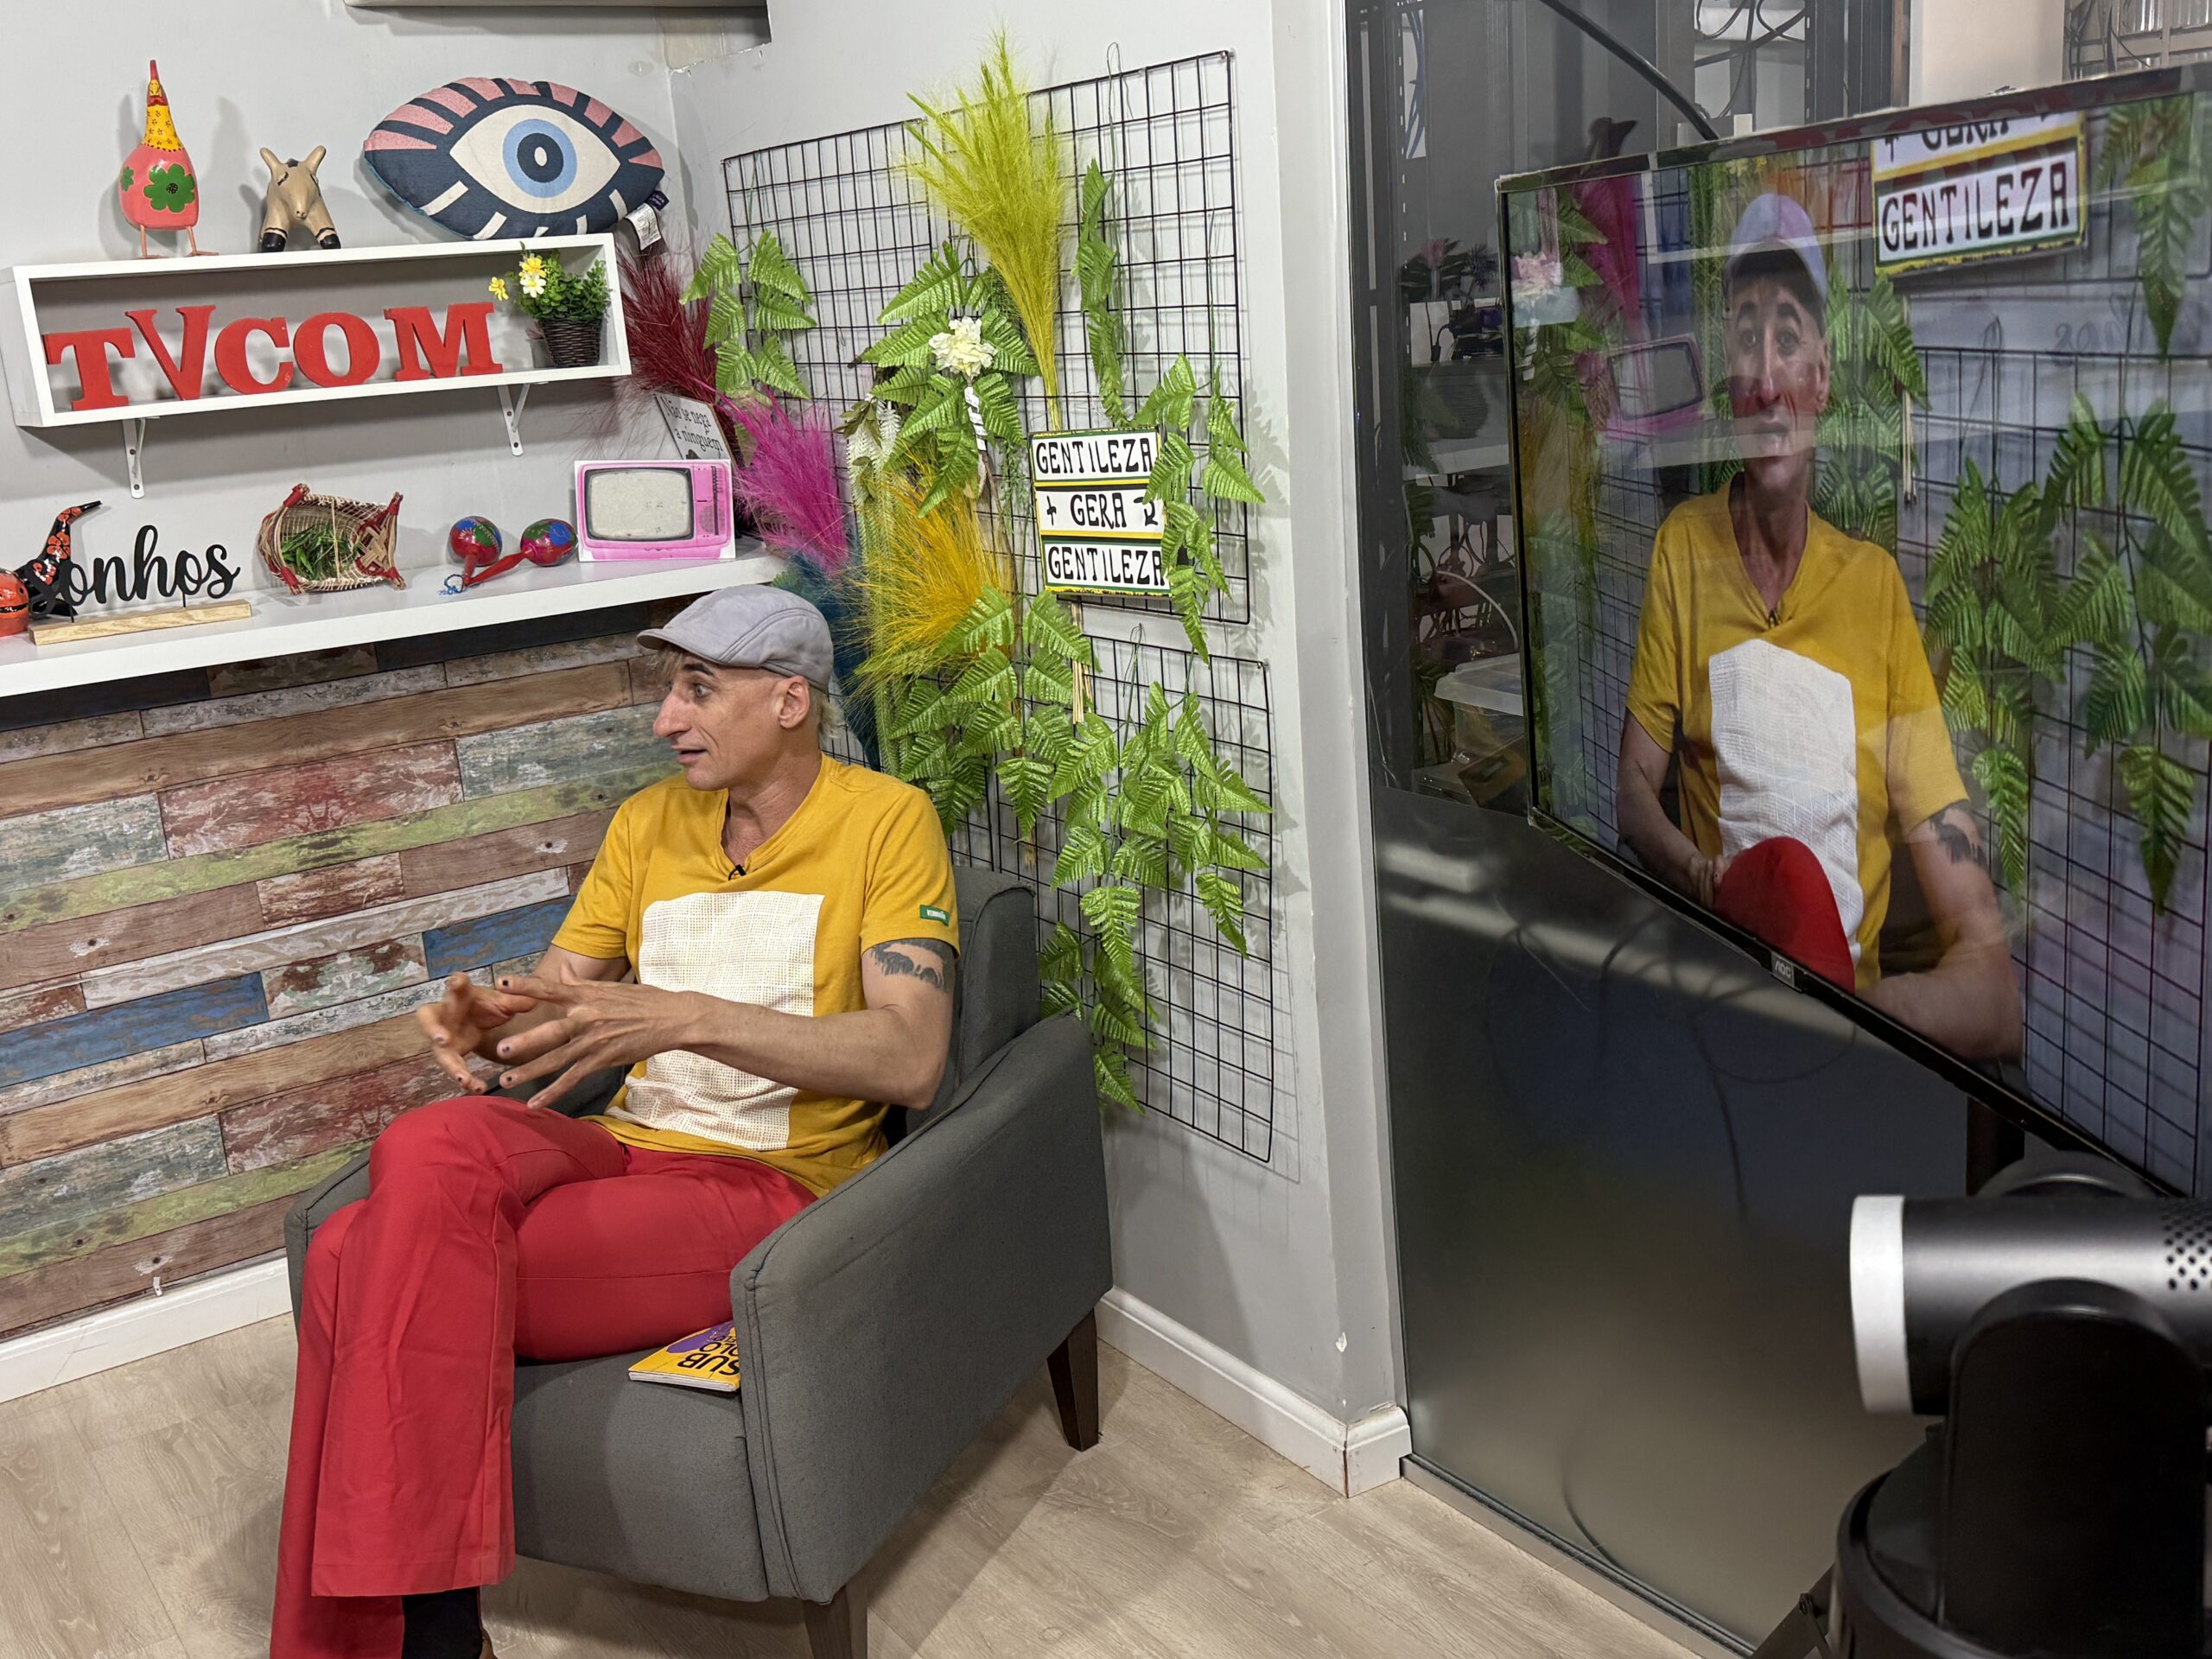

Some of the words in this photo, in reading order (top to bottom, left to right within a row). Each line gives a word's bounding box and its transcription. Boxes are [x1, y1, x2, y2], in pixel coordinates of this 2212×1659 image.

[1882, 162, 2069, 251] GENTILEZA
[42, 302, 503, 410] TVCOM
[674, 428, 682, 440] a
[681, 408, 692, 423] se
[1036, 437, 1154, 474] GENTILEZA
[1070, 492, 1127, 530] GERA
[29, 524, 241, 620] Sonhos
[1048, 546, 1166, 586] GENTILEZA
[677, 1353, 740, 1376] SUB
